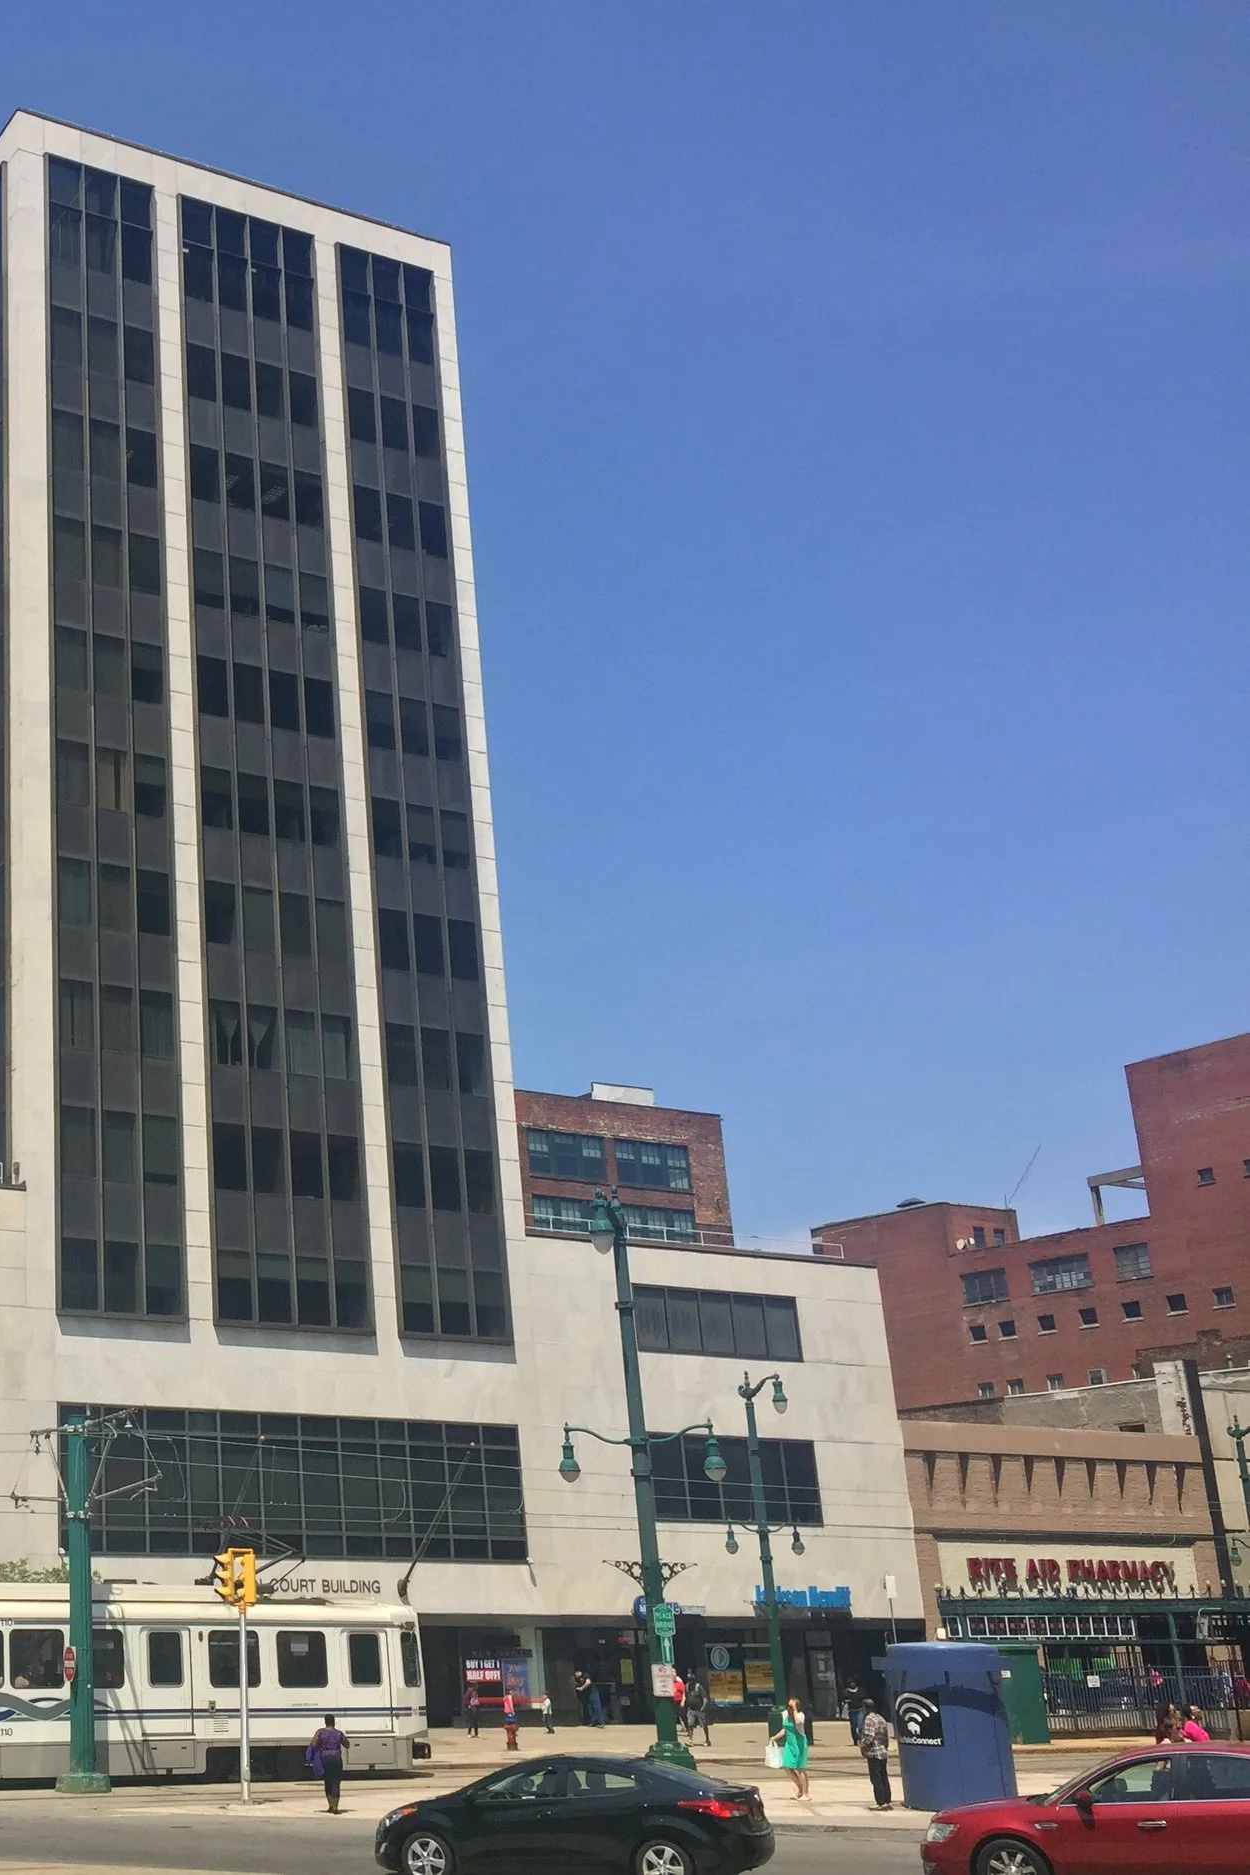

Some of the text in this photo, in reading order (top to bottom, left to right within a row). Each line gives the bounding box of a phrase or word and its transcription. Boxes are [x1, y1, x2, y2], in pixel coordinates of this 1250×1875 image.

[966, 1558, 1175, 1584] RITE AID PHARMACY
[269, 1578, 316, 1593] COURT
[322, 1579, 381, 1594] BUILDING
[465, 1659, 479, 1669] BUY
[484, 1659, 495, 1669] GET
[466, 1670, 484, 1680] HALF
[0, 1728, 13, 1737] 110
